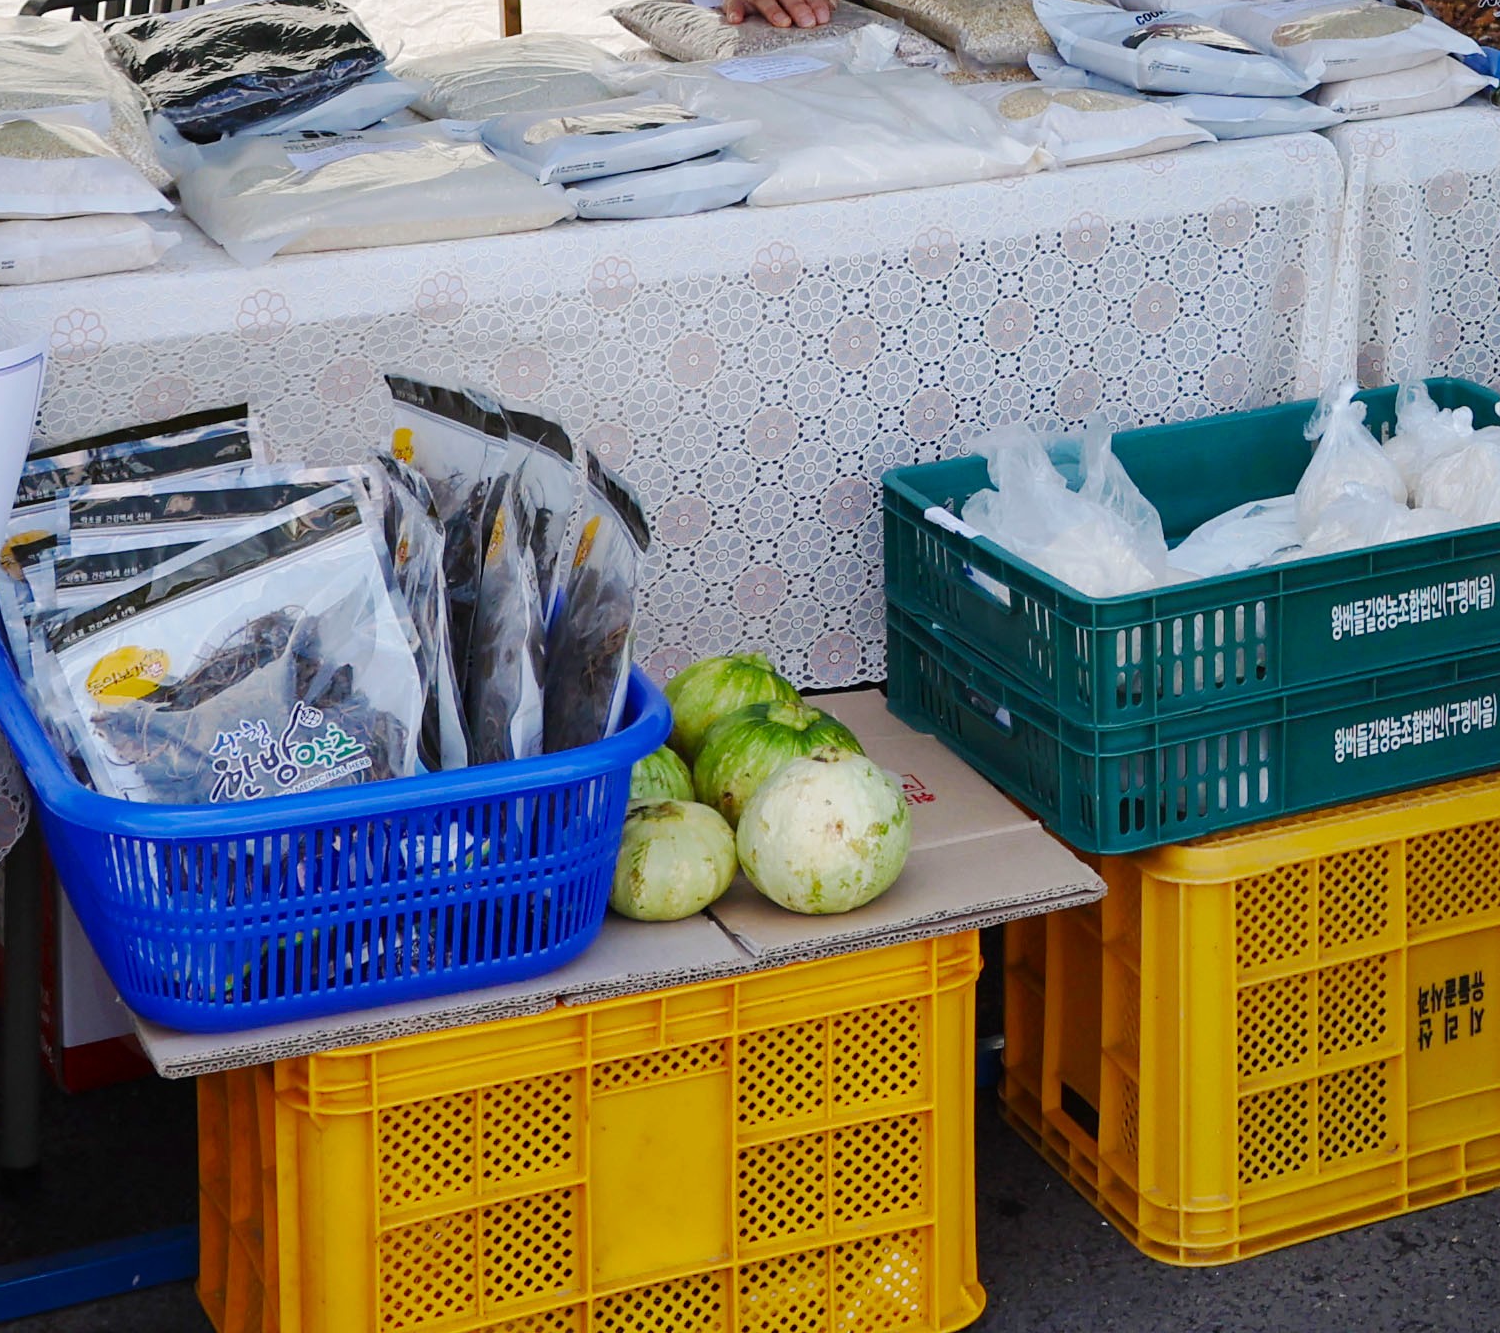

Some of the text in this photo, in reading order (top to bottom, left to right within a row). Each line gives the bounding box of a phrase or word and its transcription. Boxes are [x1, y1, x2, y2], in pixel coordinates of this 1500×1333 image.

[209, 719, 272, 758] 산청
[293, 757, 373, 794] MEDICINAL HERB
